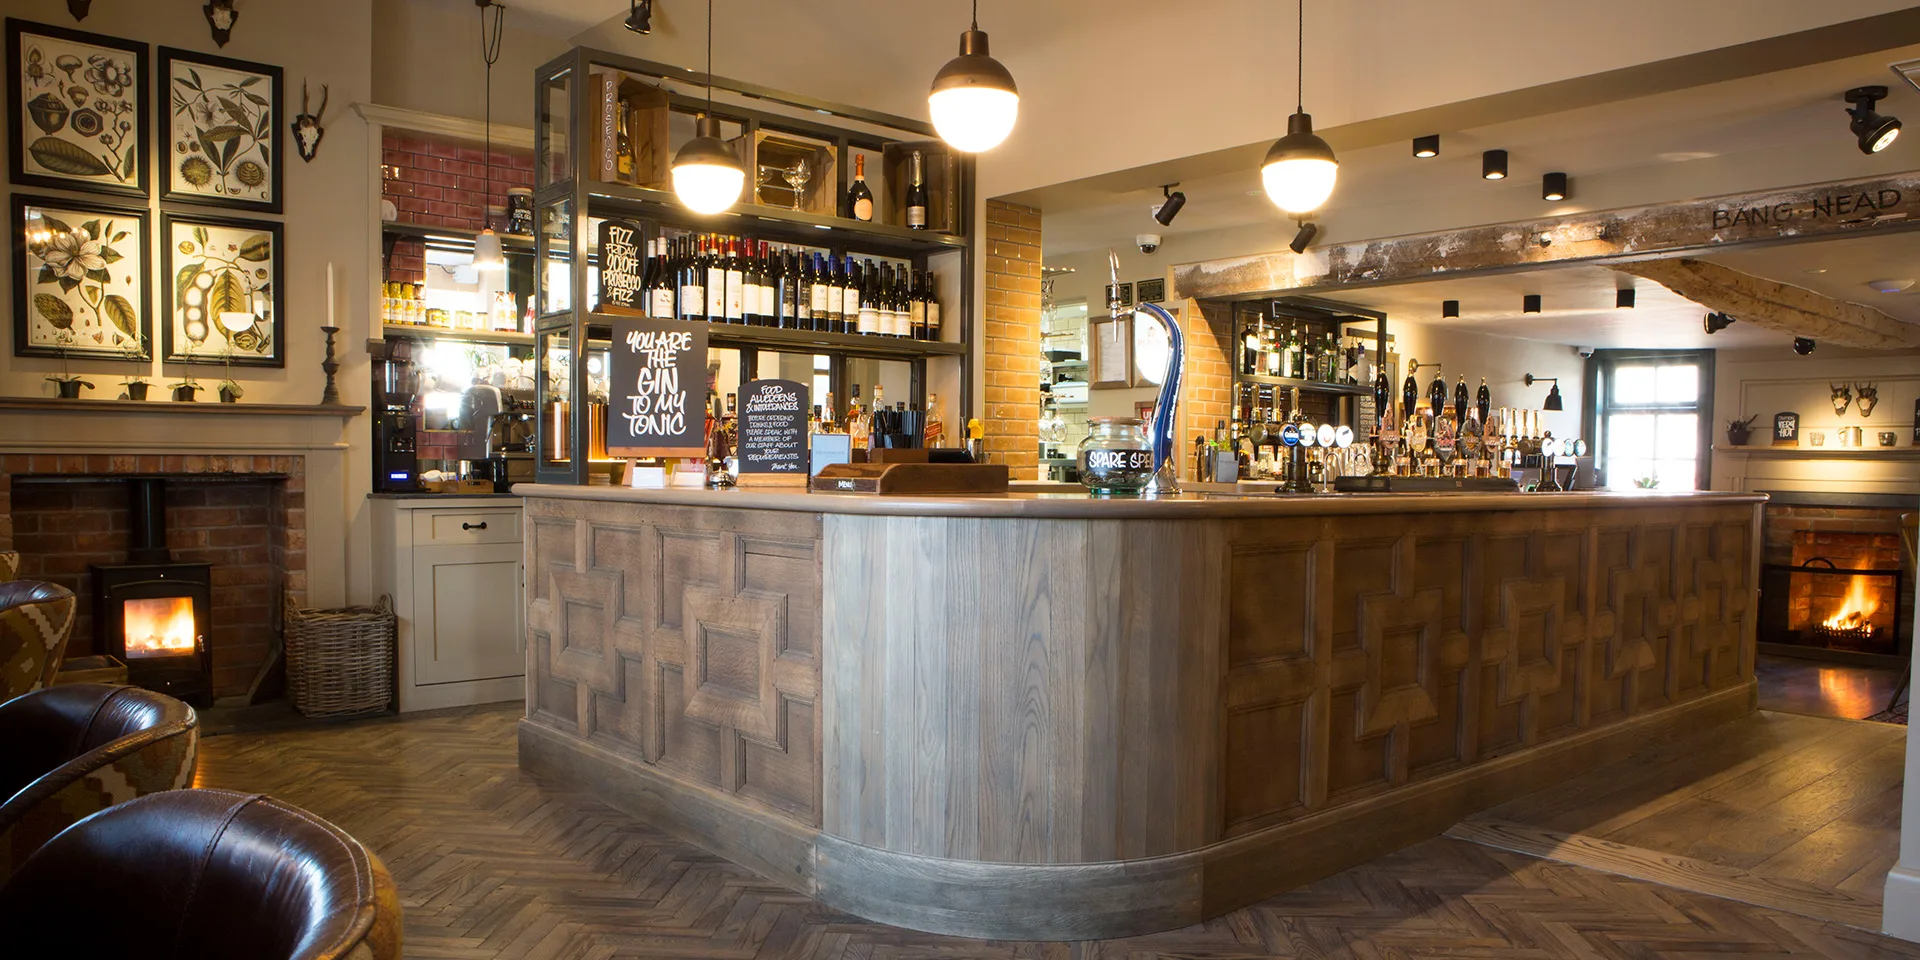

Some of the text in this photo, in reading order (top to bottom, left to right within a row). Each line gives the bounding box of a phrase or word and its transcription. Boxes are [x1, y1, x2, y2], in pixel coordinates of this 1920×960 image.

[605, 81, 614, 171] PROSECCO
[1711, 188, 1902, 230] BANG HEAD
[609, 226, 634, 247] FIZZ
[605, 243, 638, 259] FRIDAY
[602, 270, 641, 292] PROSECCO
[626, 330, 692, 353] YOU ARE
[640, 348, 677, 369] THE
[637, 367, 679, 396] GIN
[761, 385, 783, 395] FOOD
[626, 390, 686, 415] TO MY
[750, 392, 798, 404] ALLERGENS
[622, 412, 687, 437] TONIC
[1778, 420, 1795, 430] VERY
[1778, 428, 1793, 438] HOT
[1088, 451, 1126, 468] SPARE
